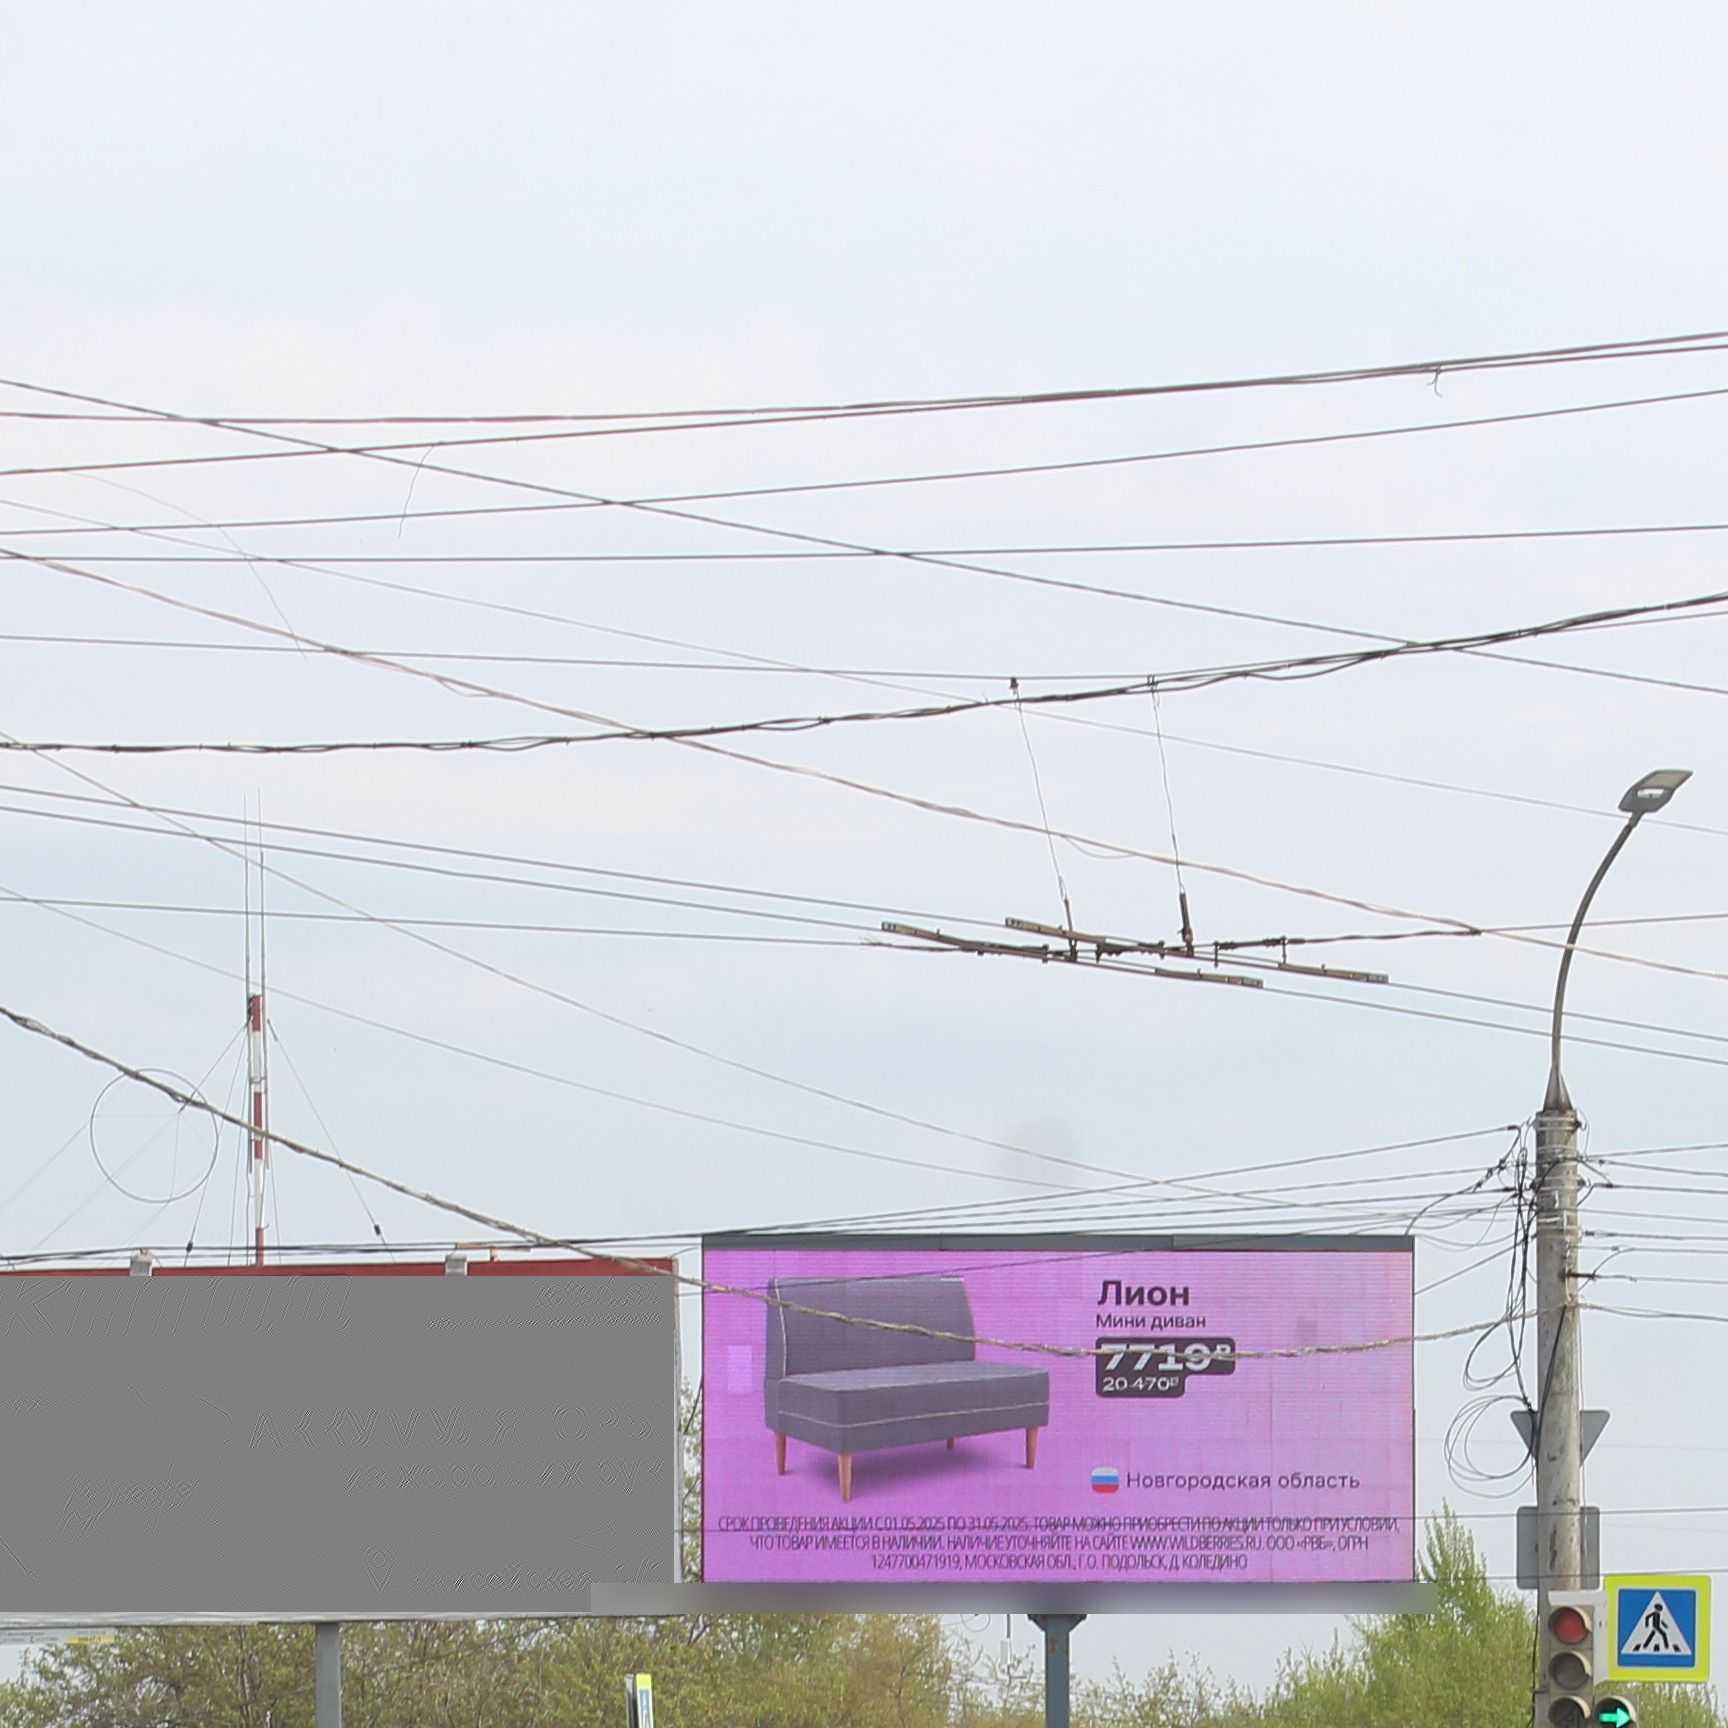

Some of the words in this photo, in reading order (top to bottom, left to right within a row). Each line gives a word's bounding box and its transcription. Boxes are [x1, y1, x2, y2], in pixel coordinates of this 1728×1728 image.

[1097, 1279, 1190, 1306] Лион
[1096, 1314, 1146, 1329] Мини
[1150, 1316, 1206, 1331] диван
[1102, 1377, 1128, 1392] 20
[1126, 1472, 1271, 1491] Новгородская
[1278, 1471, 1360, 1489] область
